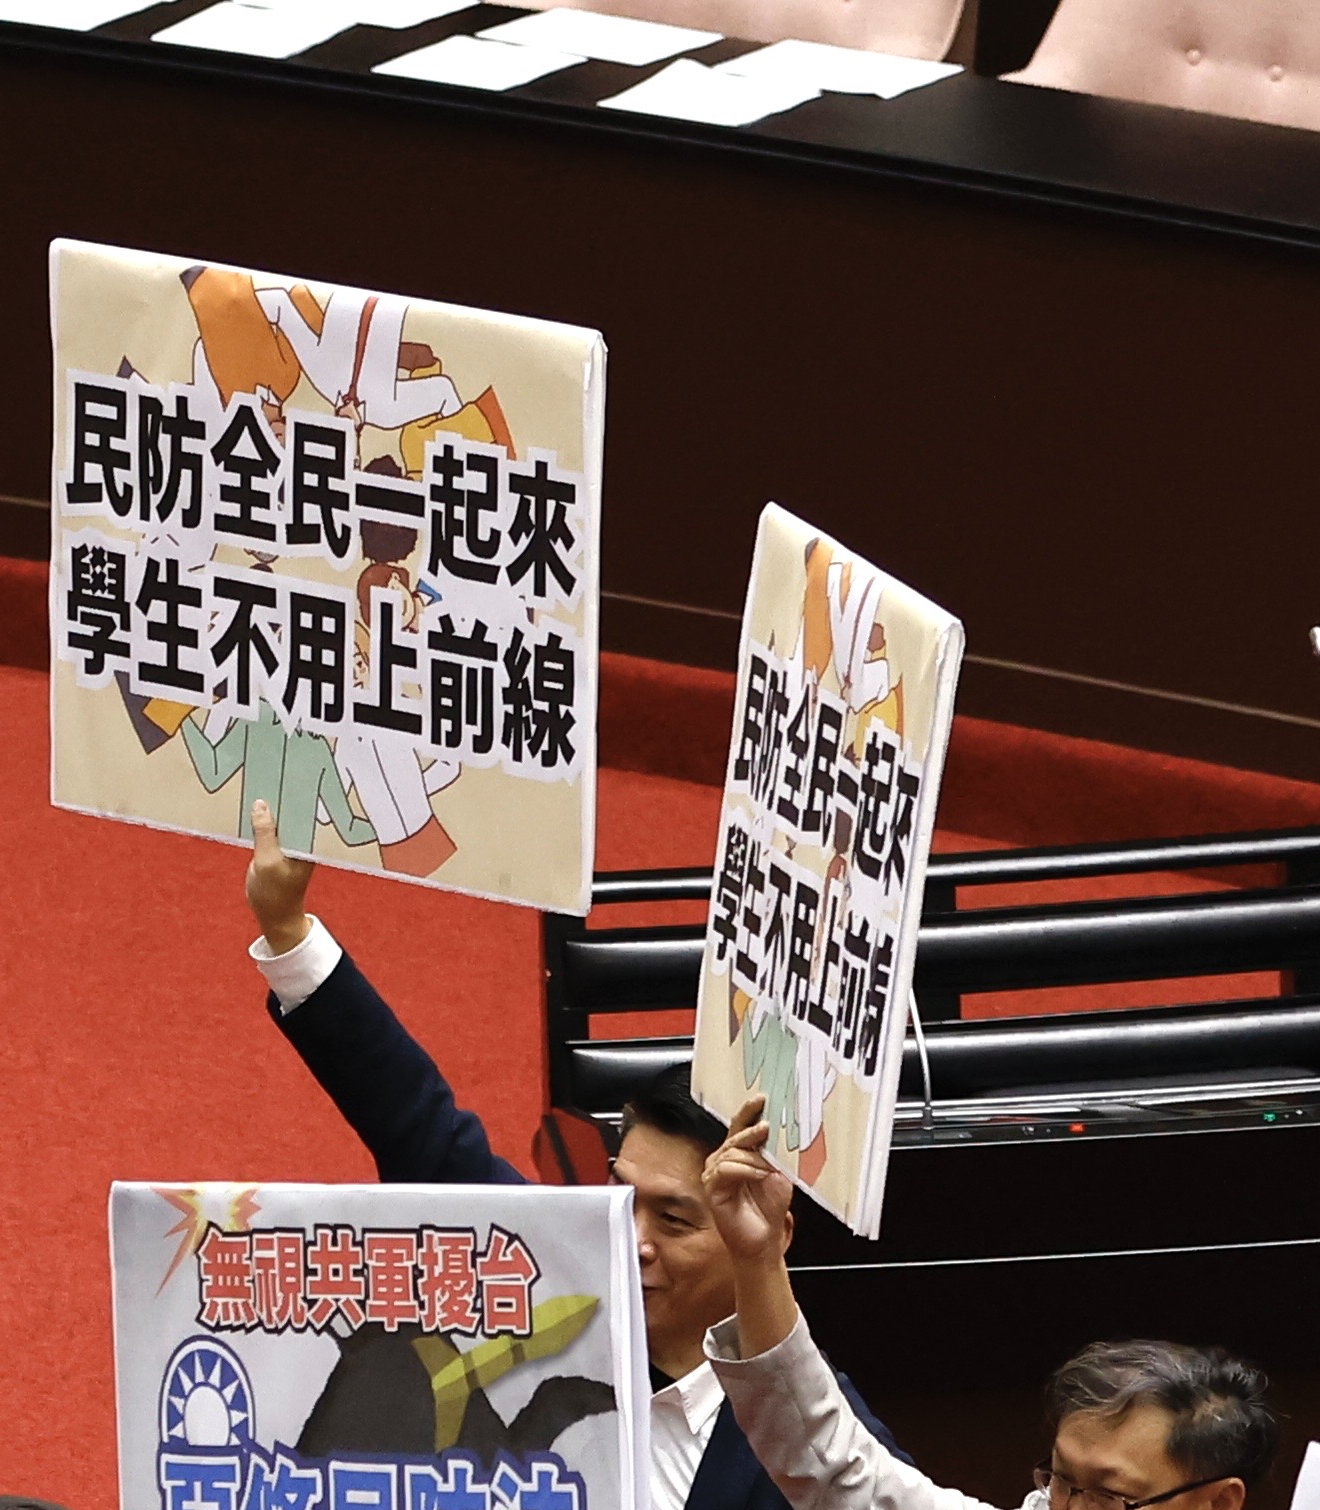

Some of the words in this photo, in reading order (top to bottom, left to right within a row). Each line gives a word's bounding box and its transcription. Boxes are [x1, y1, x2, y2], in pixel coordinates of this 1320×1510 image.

[65, 381, 578, 599] 民防全民一起來
[67, 545, 576, 767] 學生不用上前線
[197, 1226, 538, 1334] 無視共軍擾台
